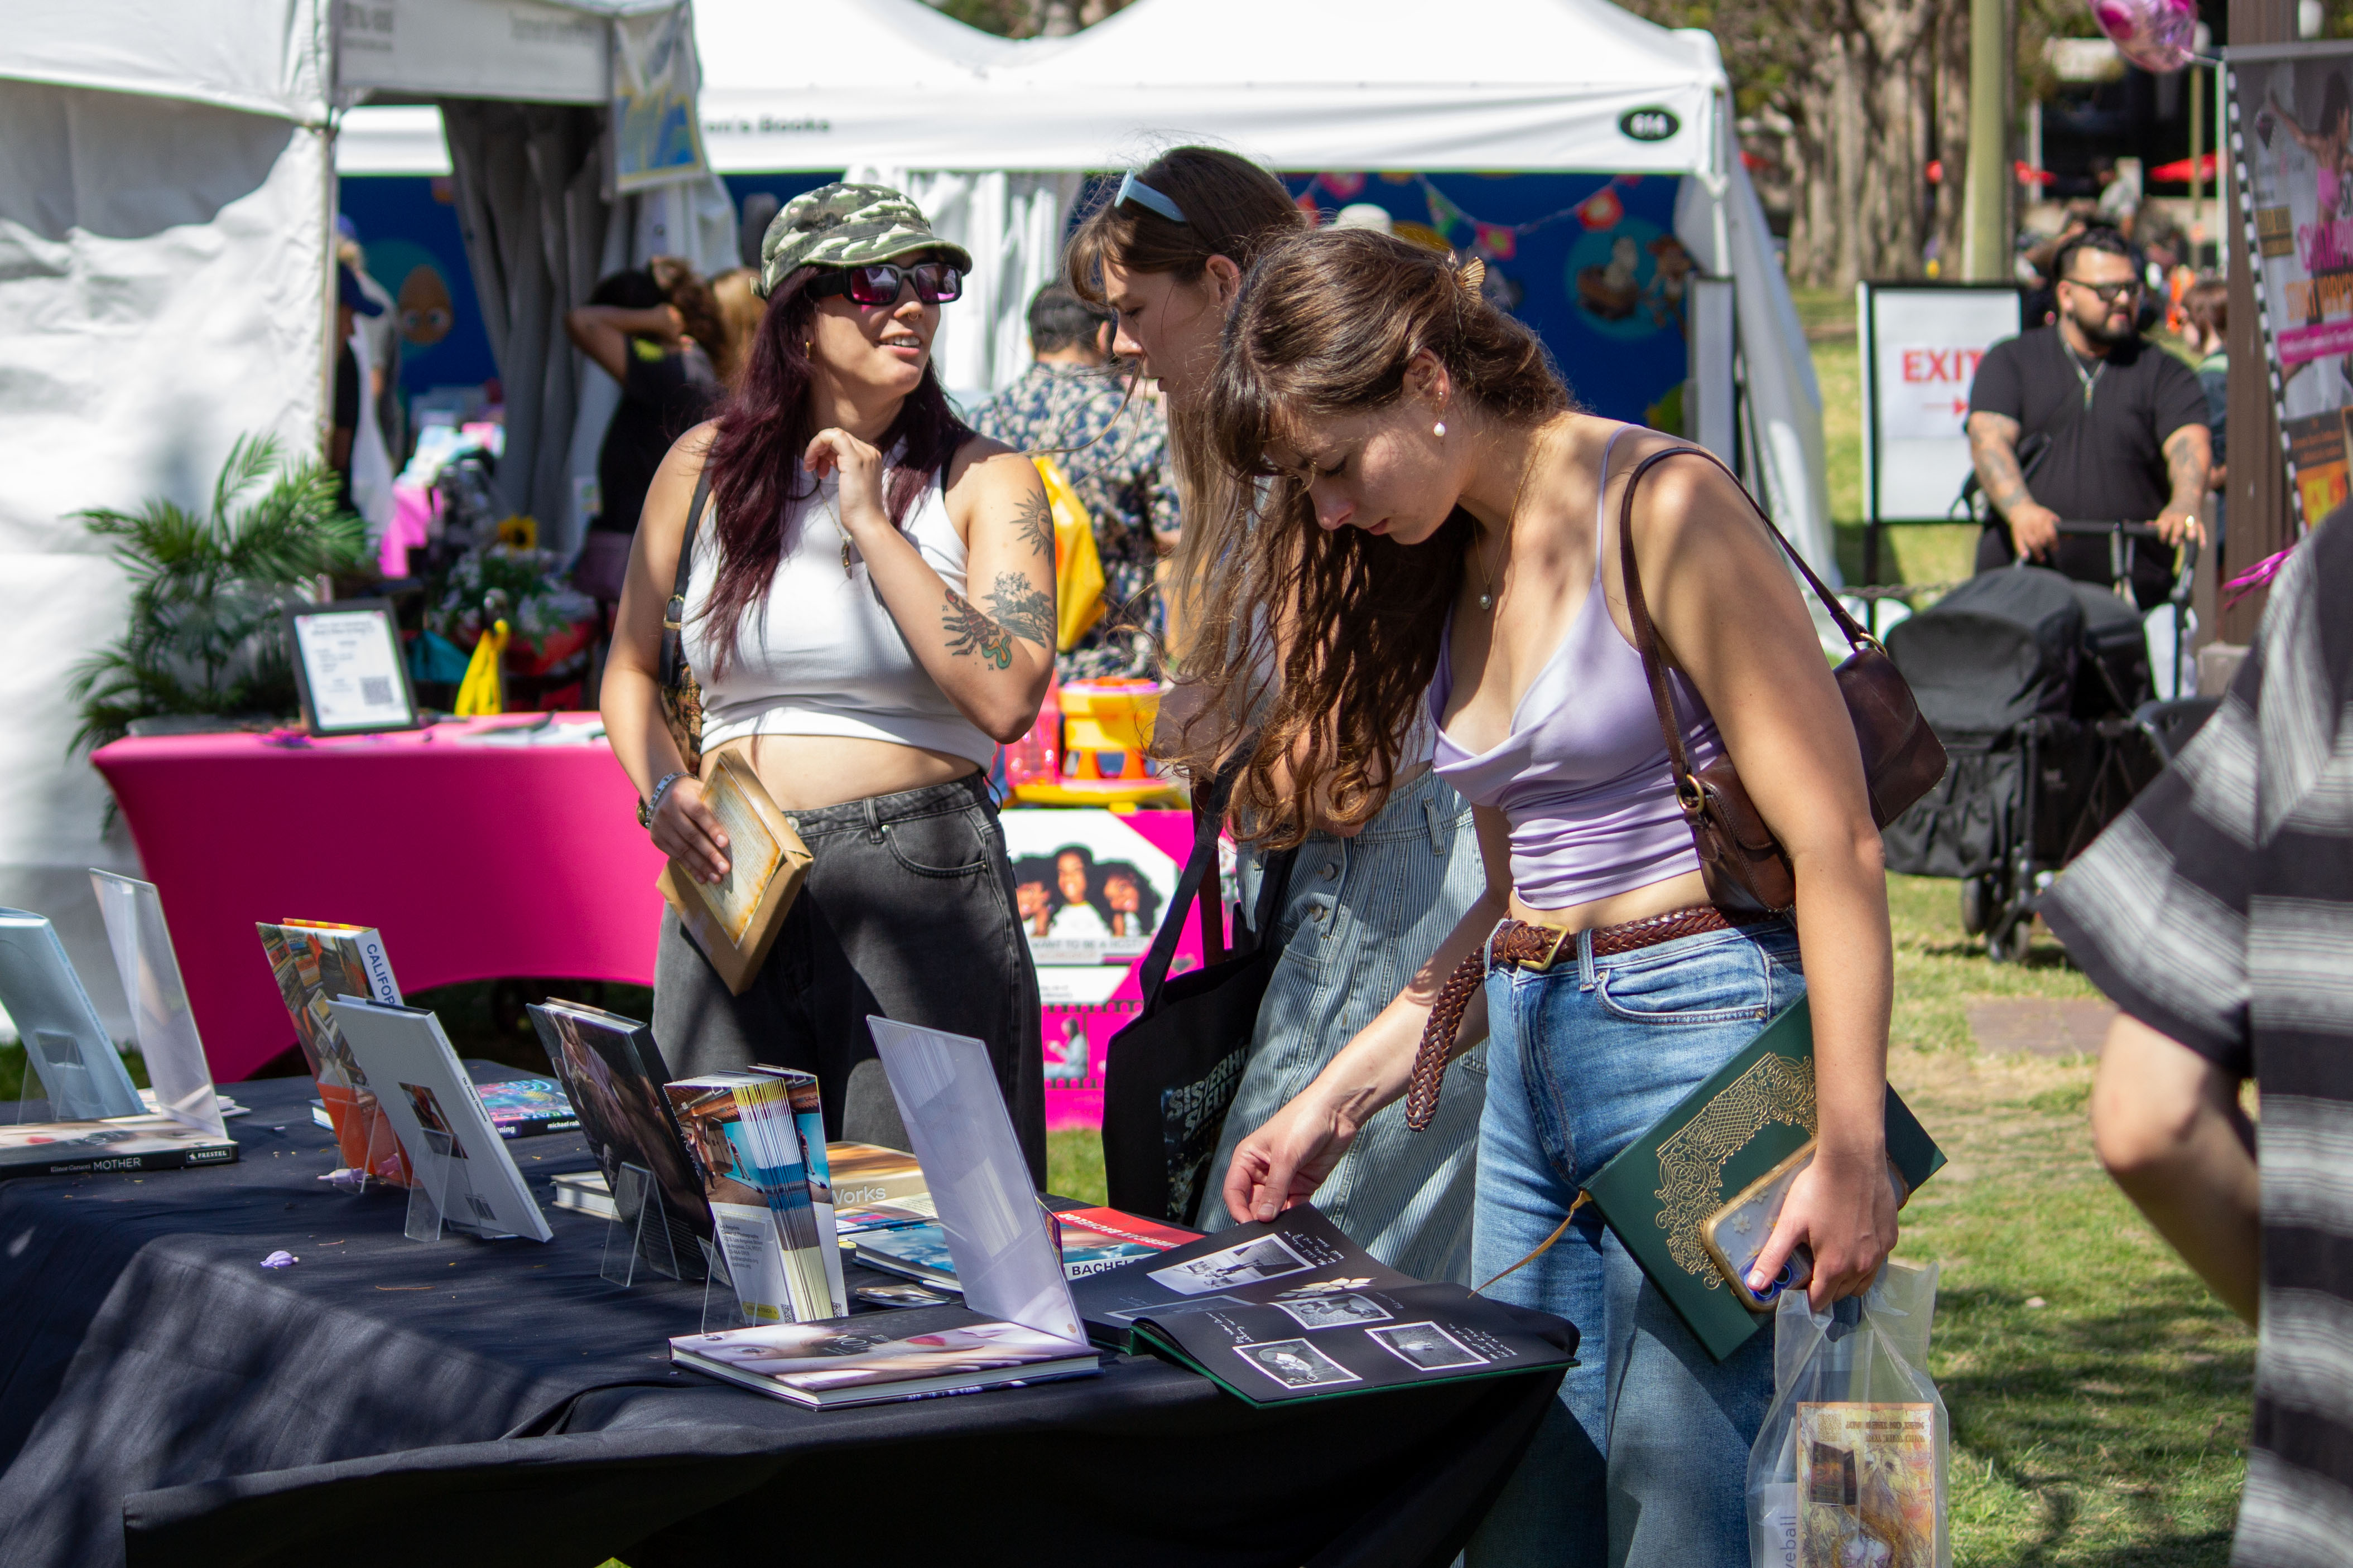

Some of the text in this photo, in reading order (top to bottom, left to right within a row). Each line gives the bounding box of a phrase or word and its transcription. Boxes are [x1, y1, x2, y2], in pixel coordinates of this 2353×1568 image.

[547, 1121, 569, 1130] michael
[93, 1157, 141, 1170] MOTHER
[198, 1150, 227, 1159] PRESTEL
[1058, 1213, 1123, 1234] BACHELOR
